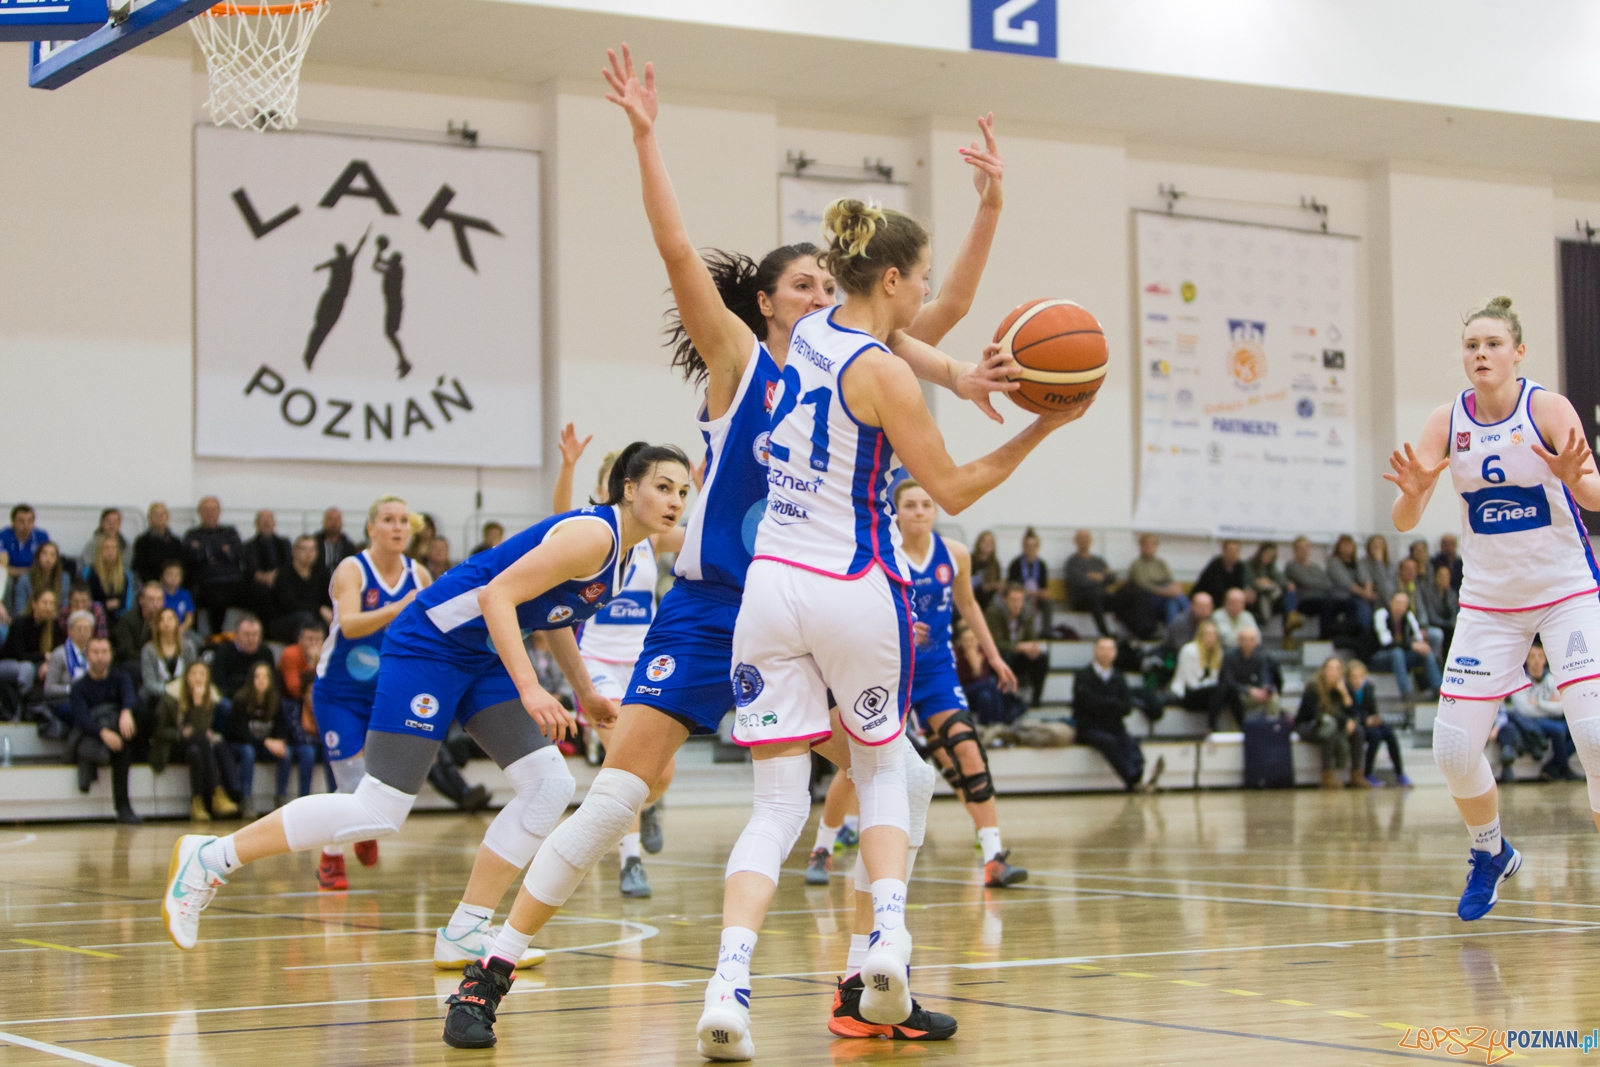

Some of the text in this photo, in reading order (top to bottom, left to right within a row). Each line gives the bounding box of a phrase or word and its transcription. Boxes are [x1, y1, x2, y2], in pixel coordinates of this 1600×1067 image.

[230, 159, 505, 275] LAK
[791, 335, 836, 374] PIETRASZEK
[243, 363, 474, 442] POZNAŃ
[769, 364, 832, 472] 21
[1482, 454, 1506, 484] 6
[1482, 506, 1538, 523] Enea
[609, 604, 647, 618] Enea
[1458, 658, 1476, 666] Ford
[1561, 658, 1595, 671] AVENIDA
[1464, 668, 1491, 676] Motors
[862, 714, 888, 732] REBIS
[731, 953, 746, 965] AZS
